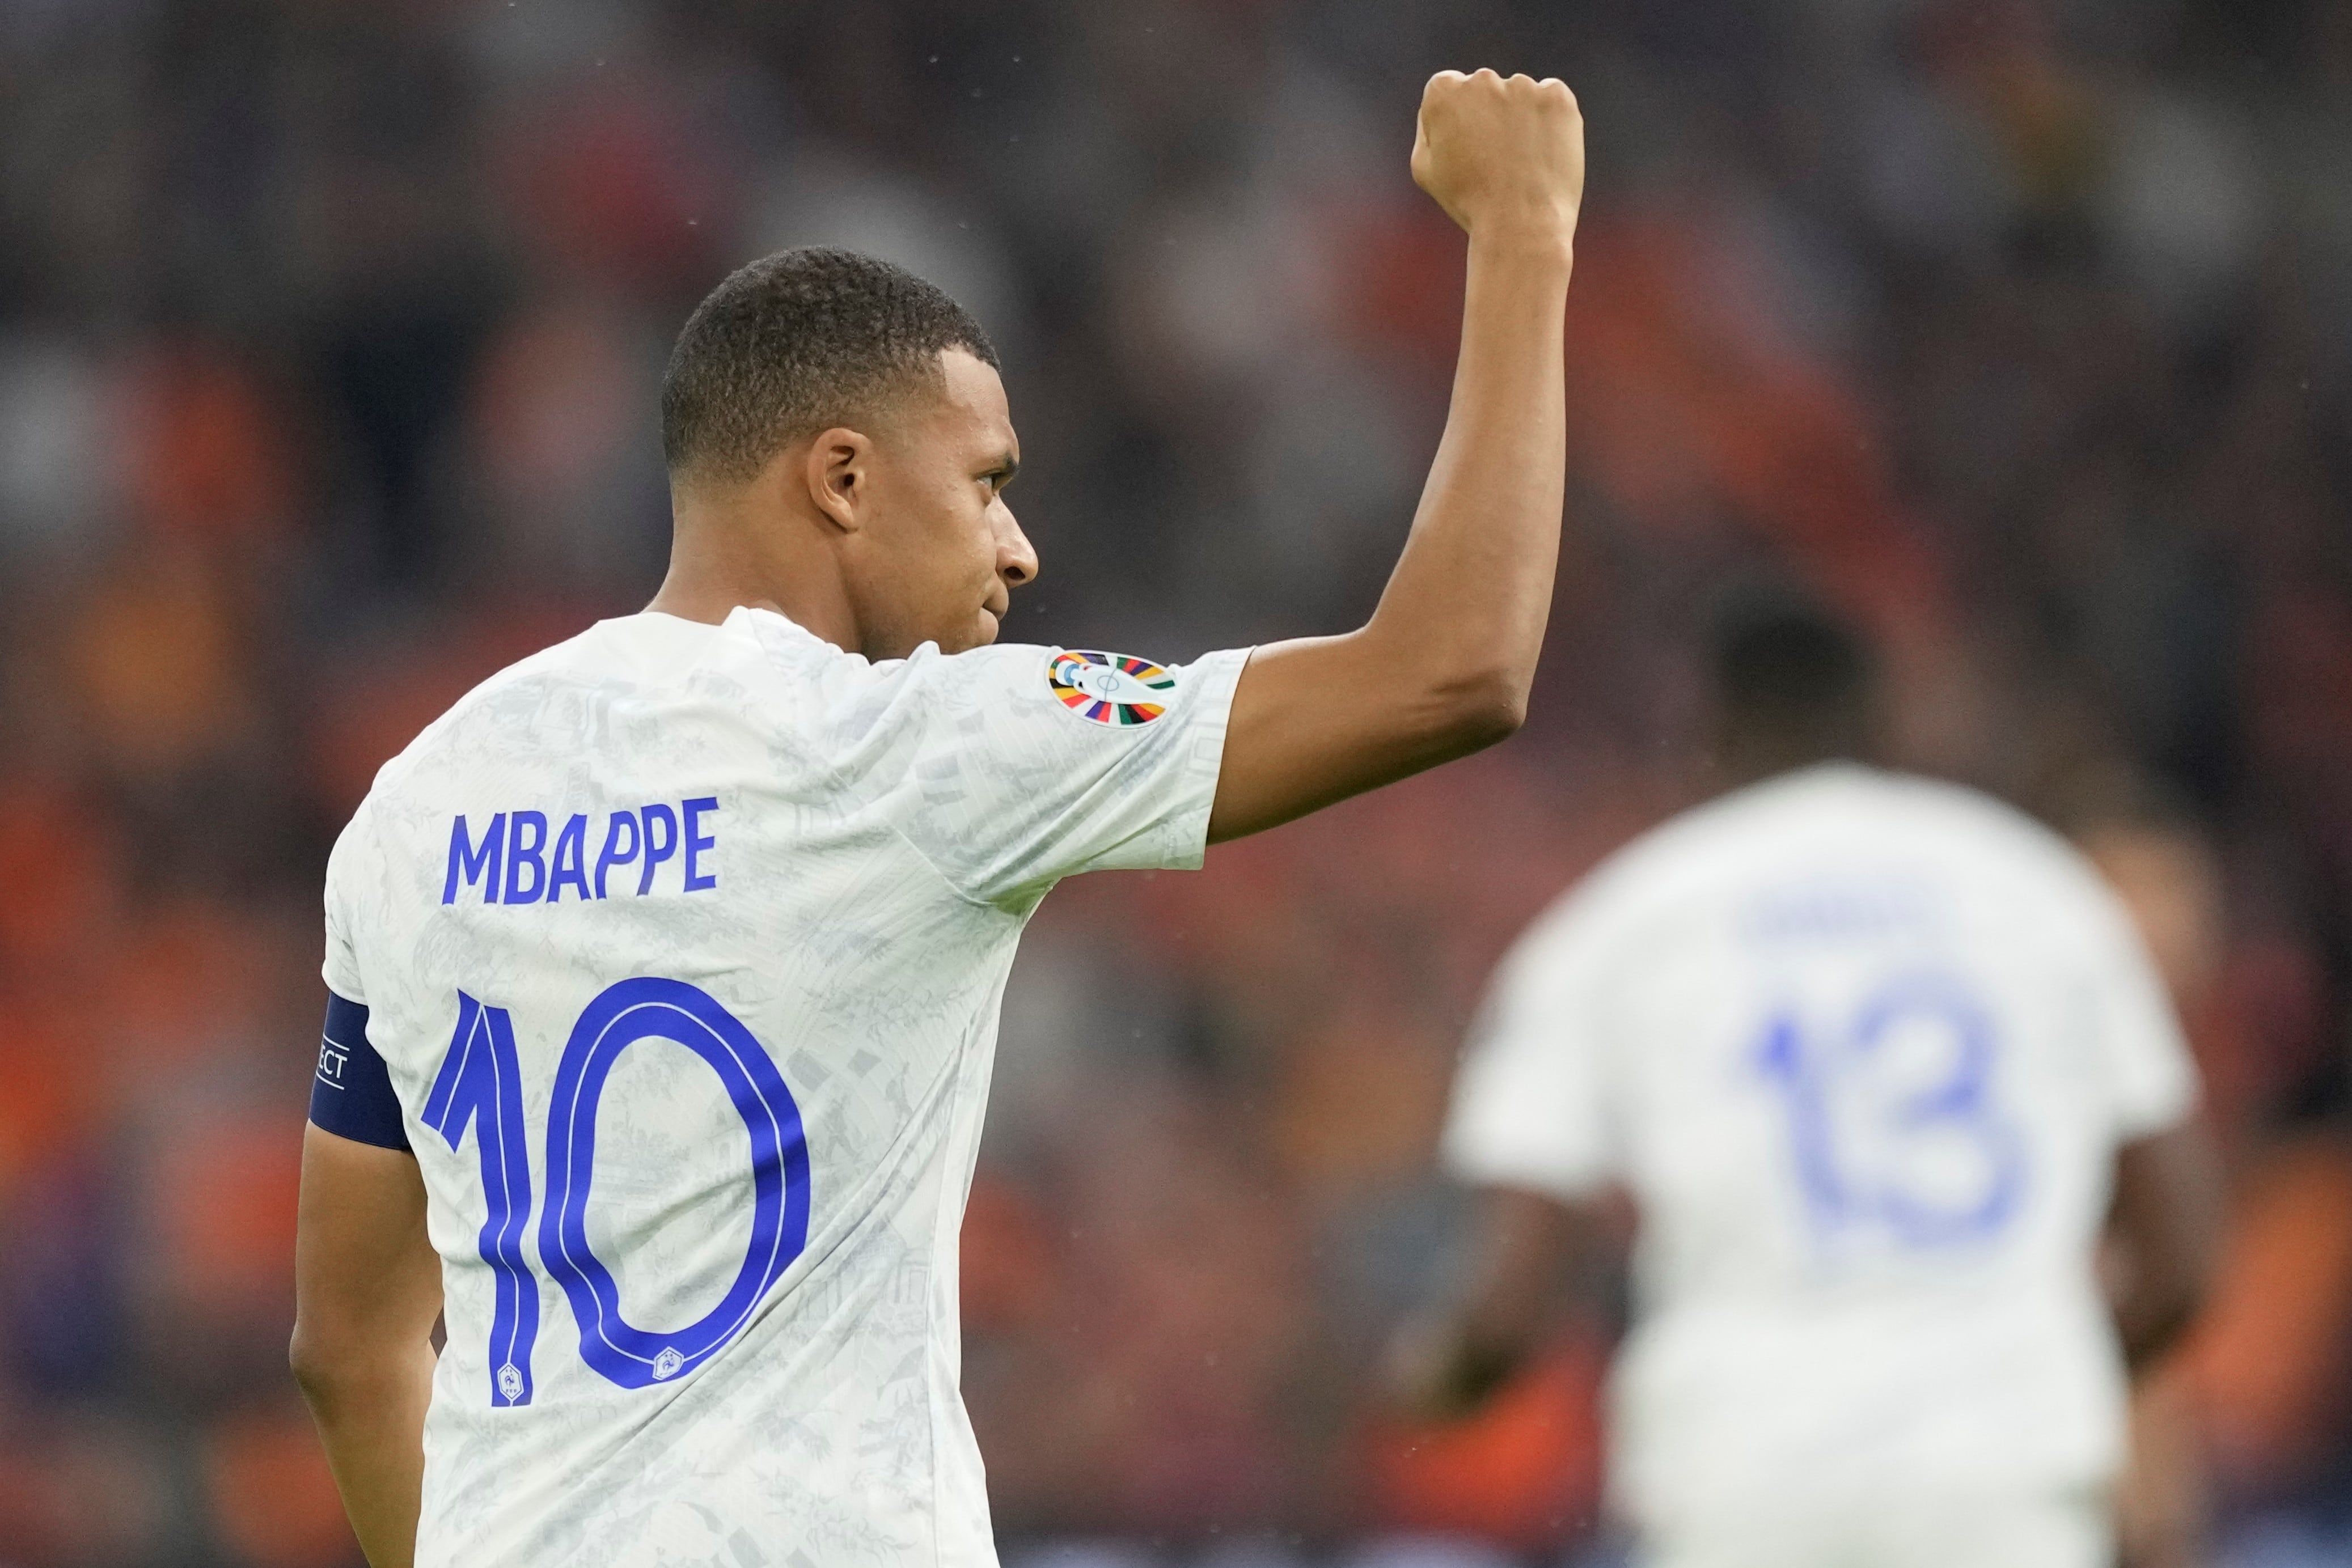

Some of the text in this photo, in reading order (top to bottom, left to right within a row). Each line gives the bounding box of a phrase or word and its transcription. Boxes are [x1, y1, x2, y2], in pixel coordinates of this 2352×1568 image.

[442, 797, 718, 905] MBAPPE
[421, 977, 811, 1407] 10
[1740, 968, 2032, 1253] 13
